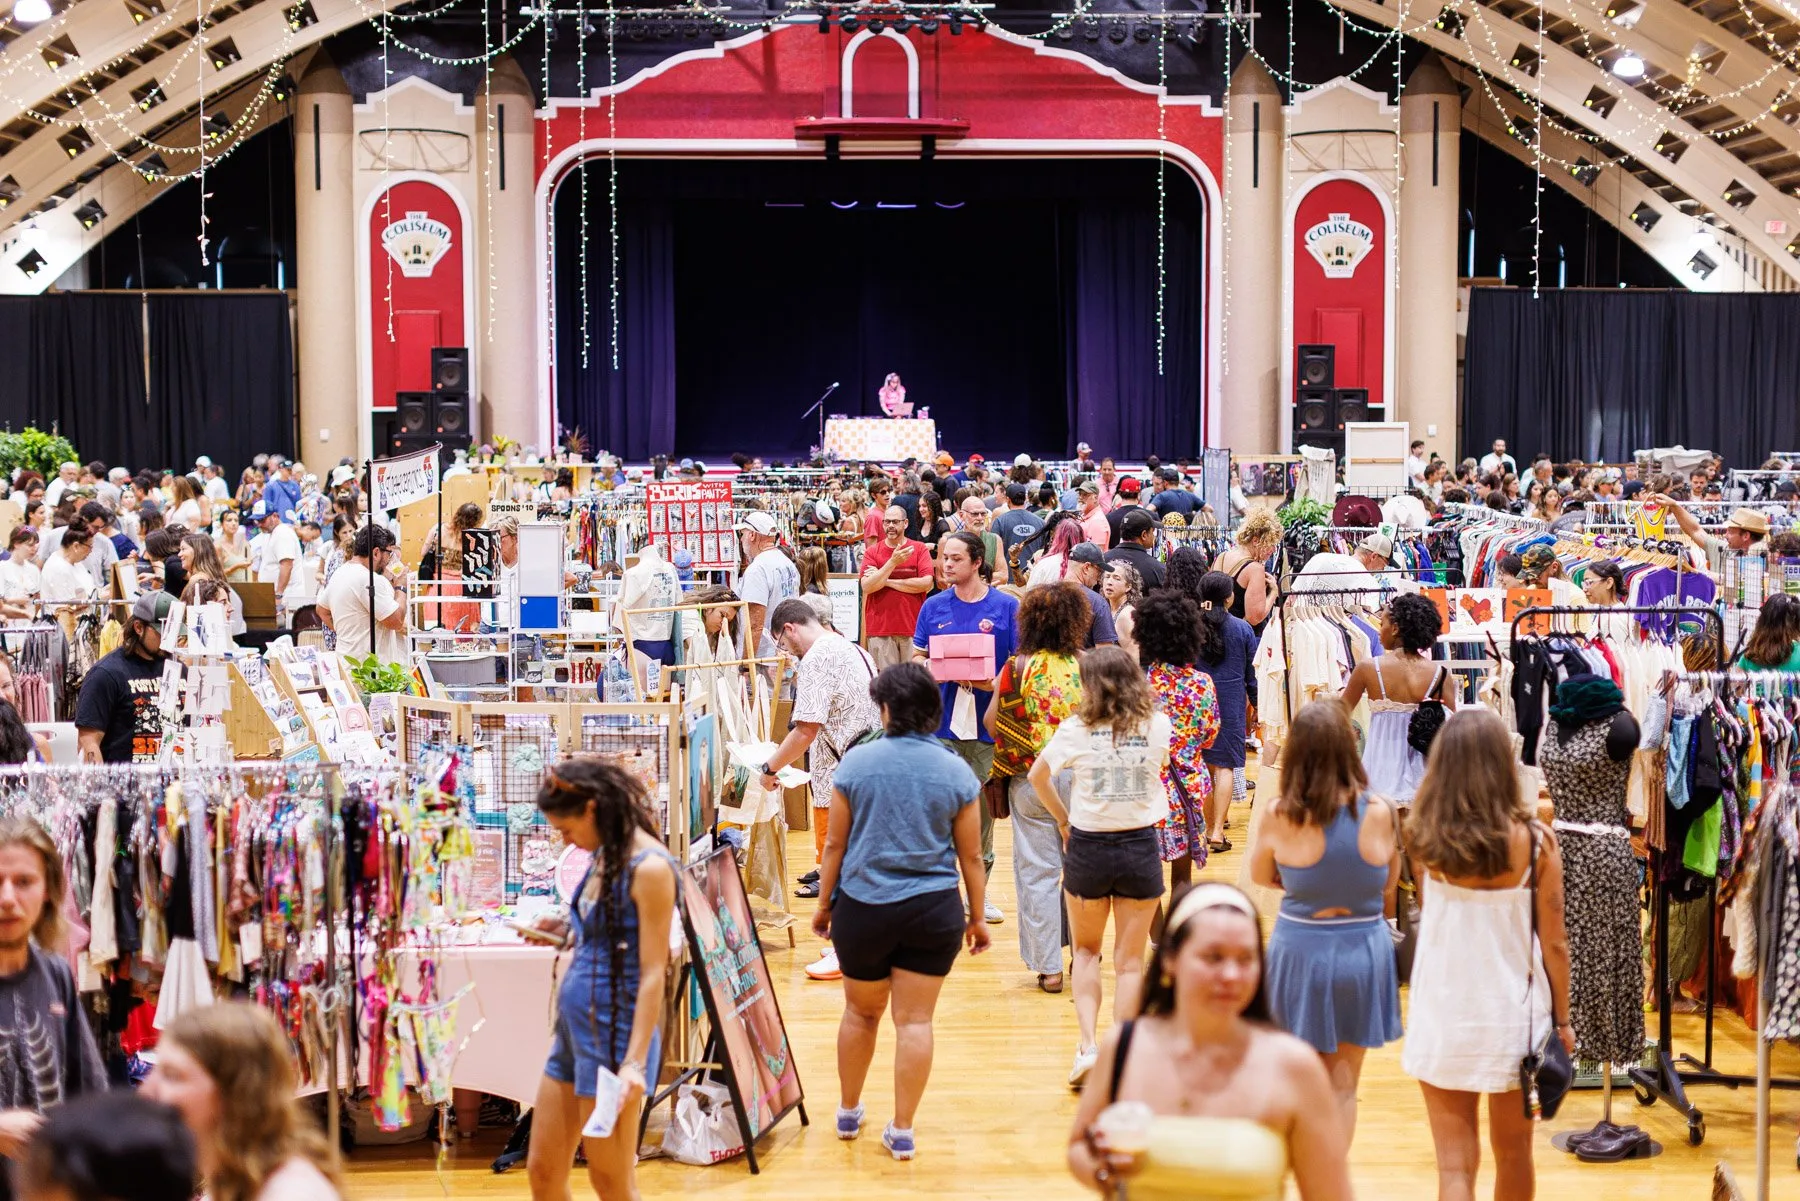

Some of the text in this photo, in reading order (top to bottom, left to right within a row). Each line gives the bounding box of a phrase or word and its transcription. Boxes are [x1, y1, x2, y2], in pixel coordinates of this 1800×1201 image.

[386, 221, 448, 240] COLISEUM
[1309, 223, 1371, 241] COLISEUM
[649, 483, 702, 502] BIRDS
[701, 488, 729, 500] PANTS
